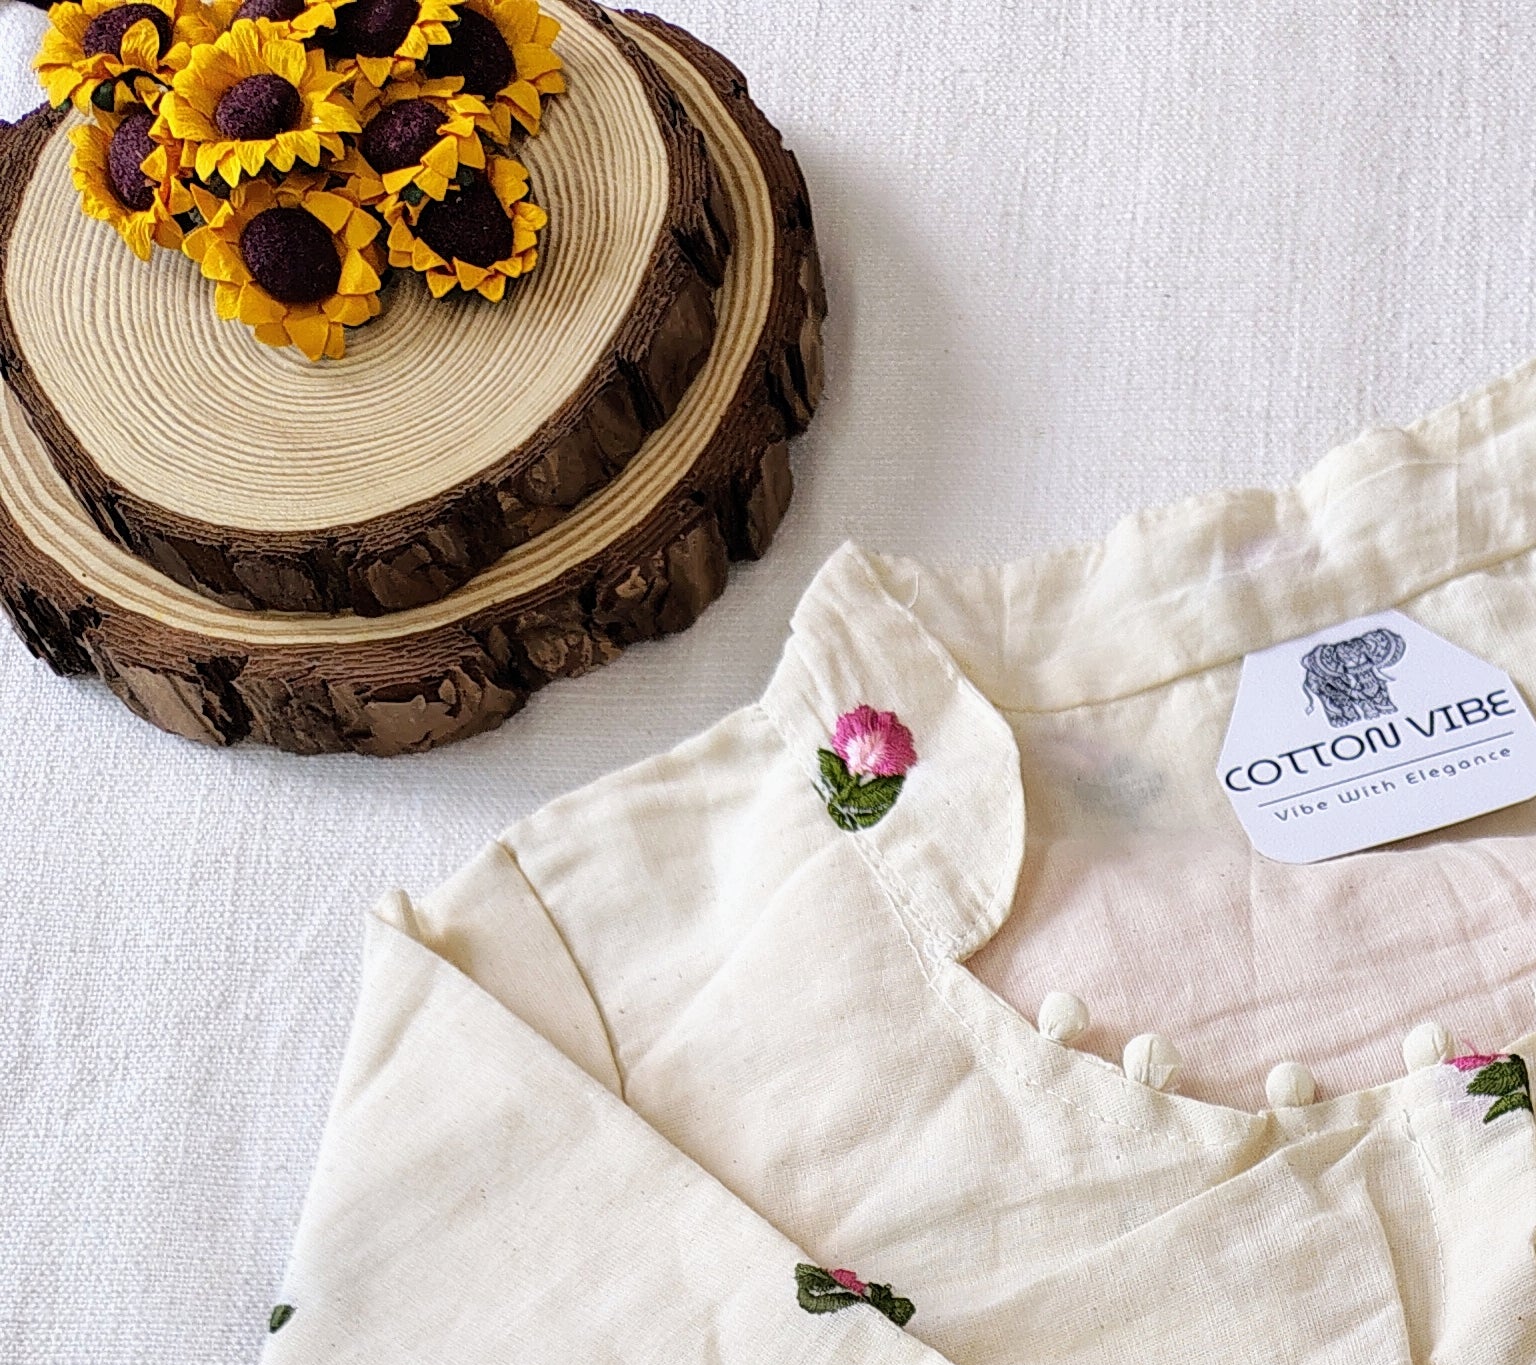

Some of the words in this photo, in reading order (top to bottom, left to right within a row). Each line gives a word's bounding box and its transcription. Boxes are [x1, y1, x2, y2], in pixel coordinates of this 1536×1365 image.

[1224, 724, 1402, 793] COTTON
[1405, 689, 1517, 738] VIBE
[1273, 798, 1329, 823] Vibe
[1337, 778, 1397, 805] With
[1405, 746, 1512, 785] Elegance
